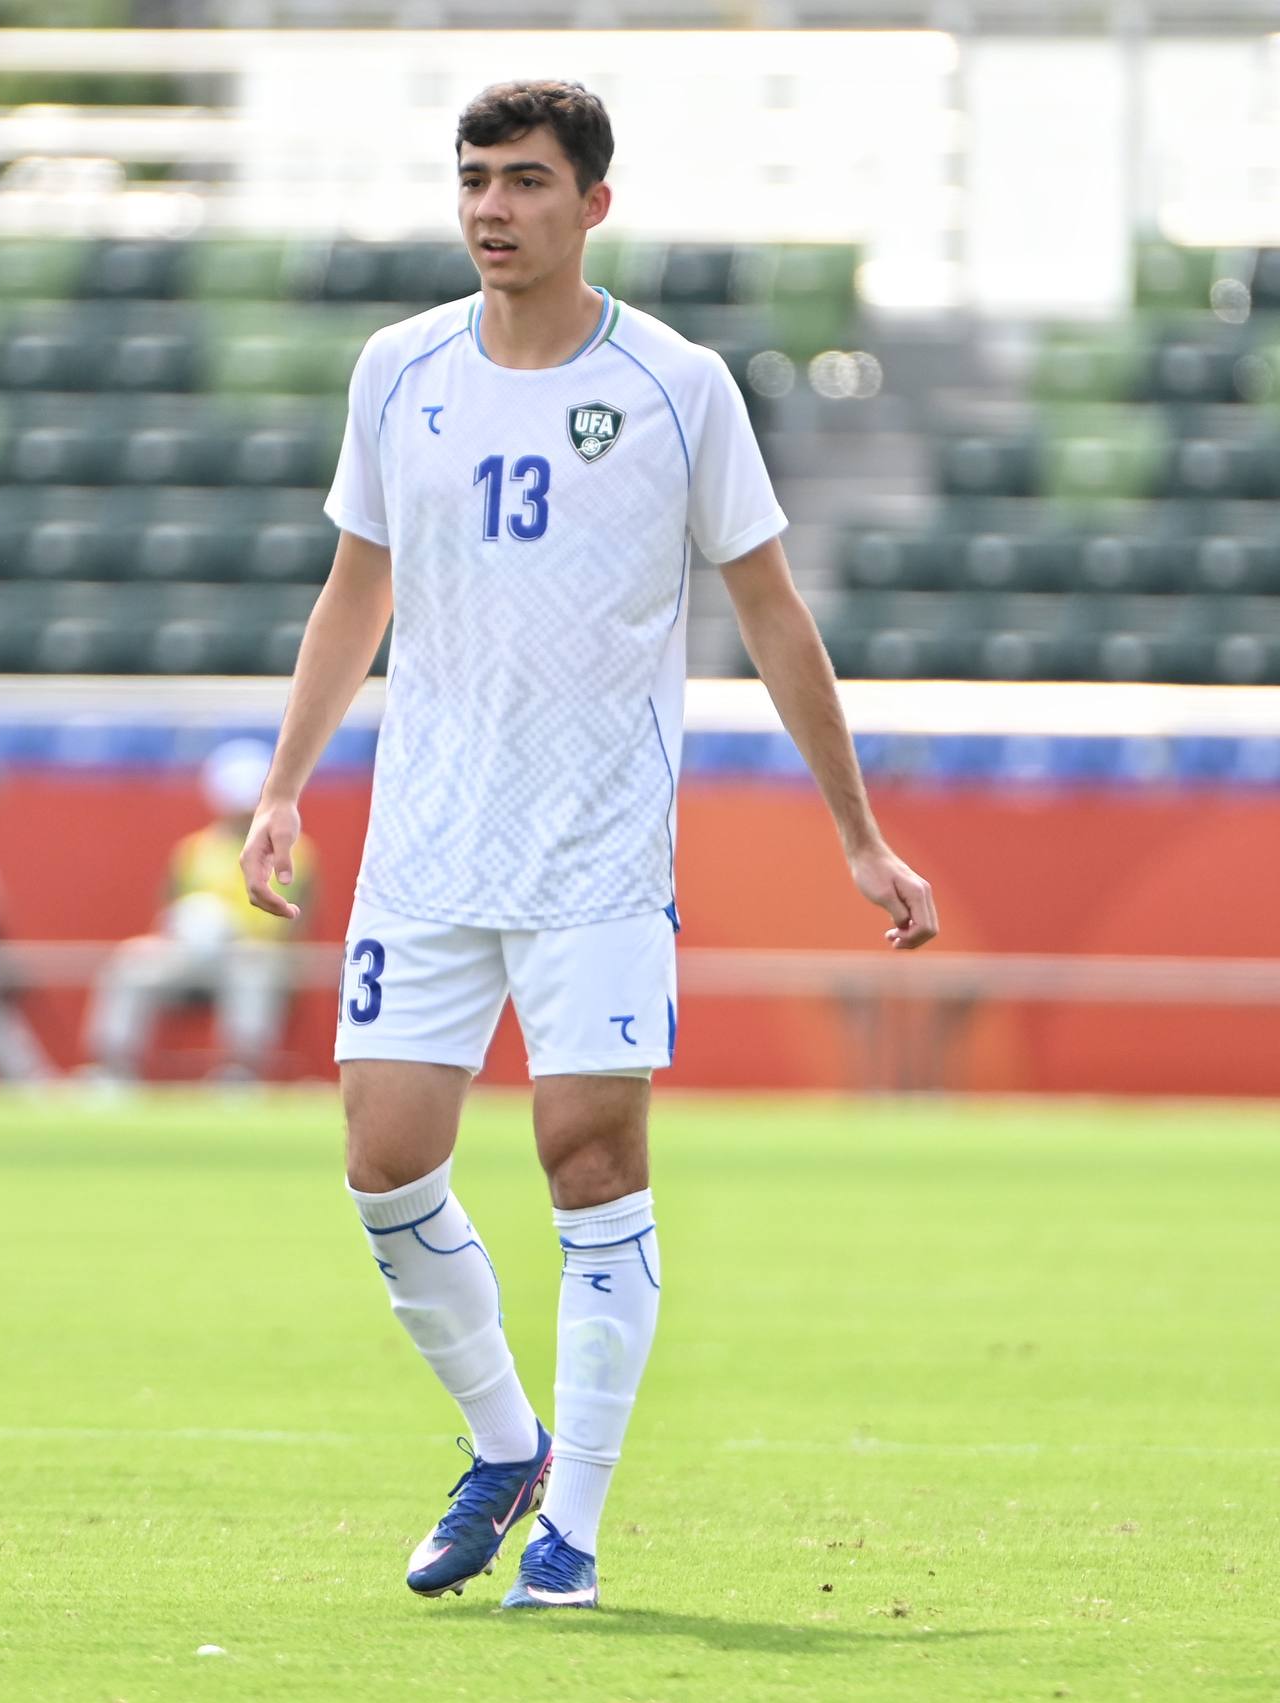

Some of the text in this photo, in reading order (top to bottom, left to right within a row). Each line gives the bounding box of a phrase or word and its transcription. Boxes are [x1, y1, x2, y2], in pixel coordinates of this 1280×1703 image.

[575, 411, 614, 436] UFA
[473, 454, 551, 542] 13
[339, 938, 386, 1027] 3
